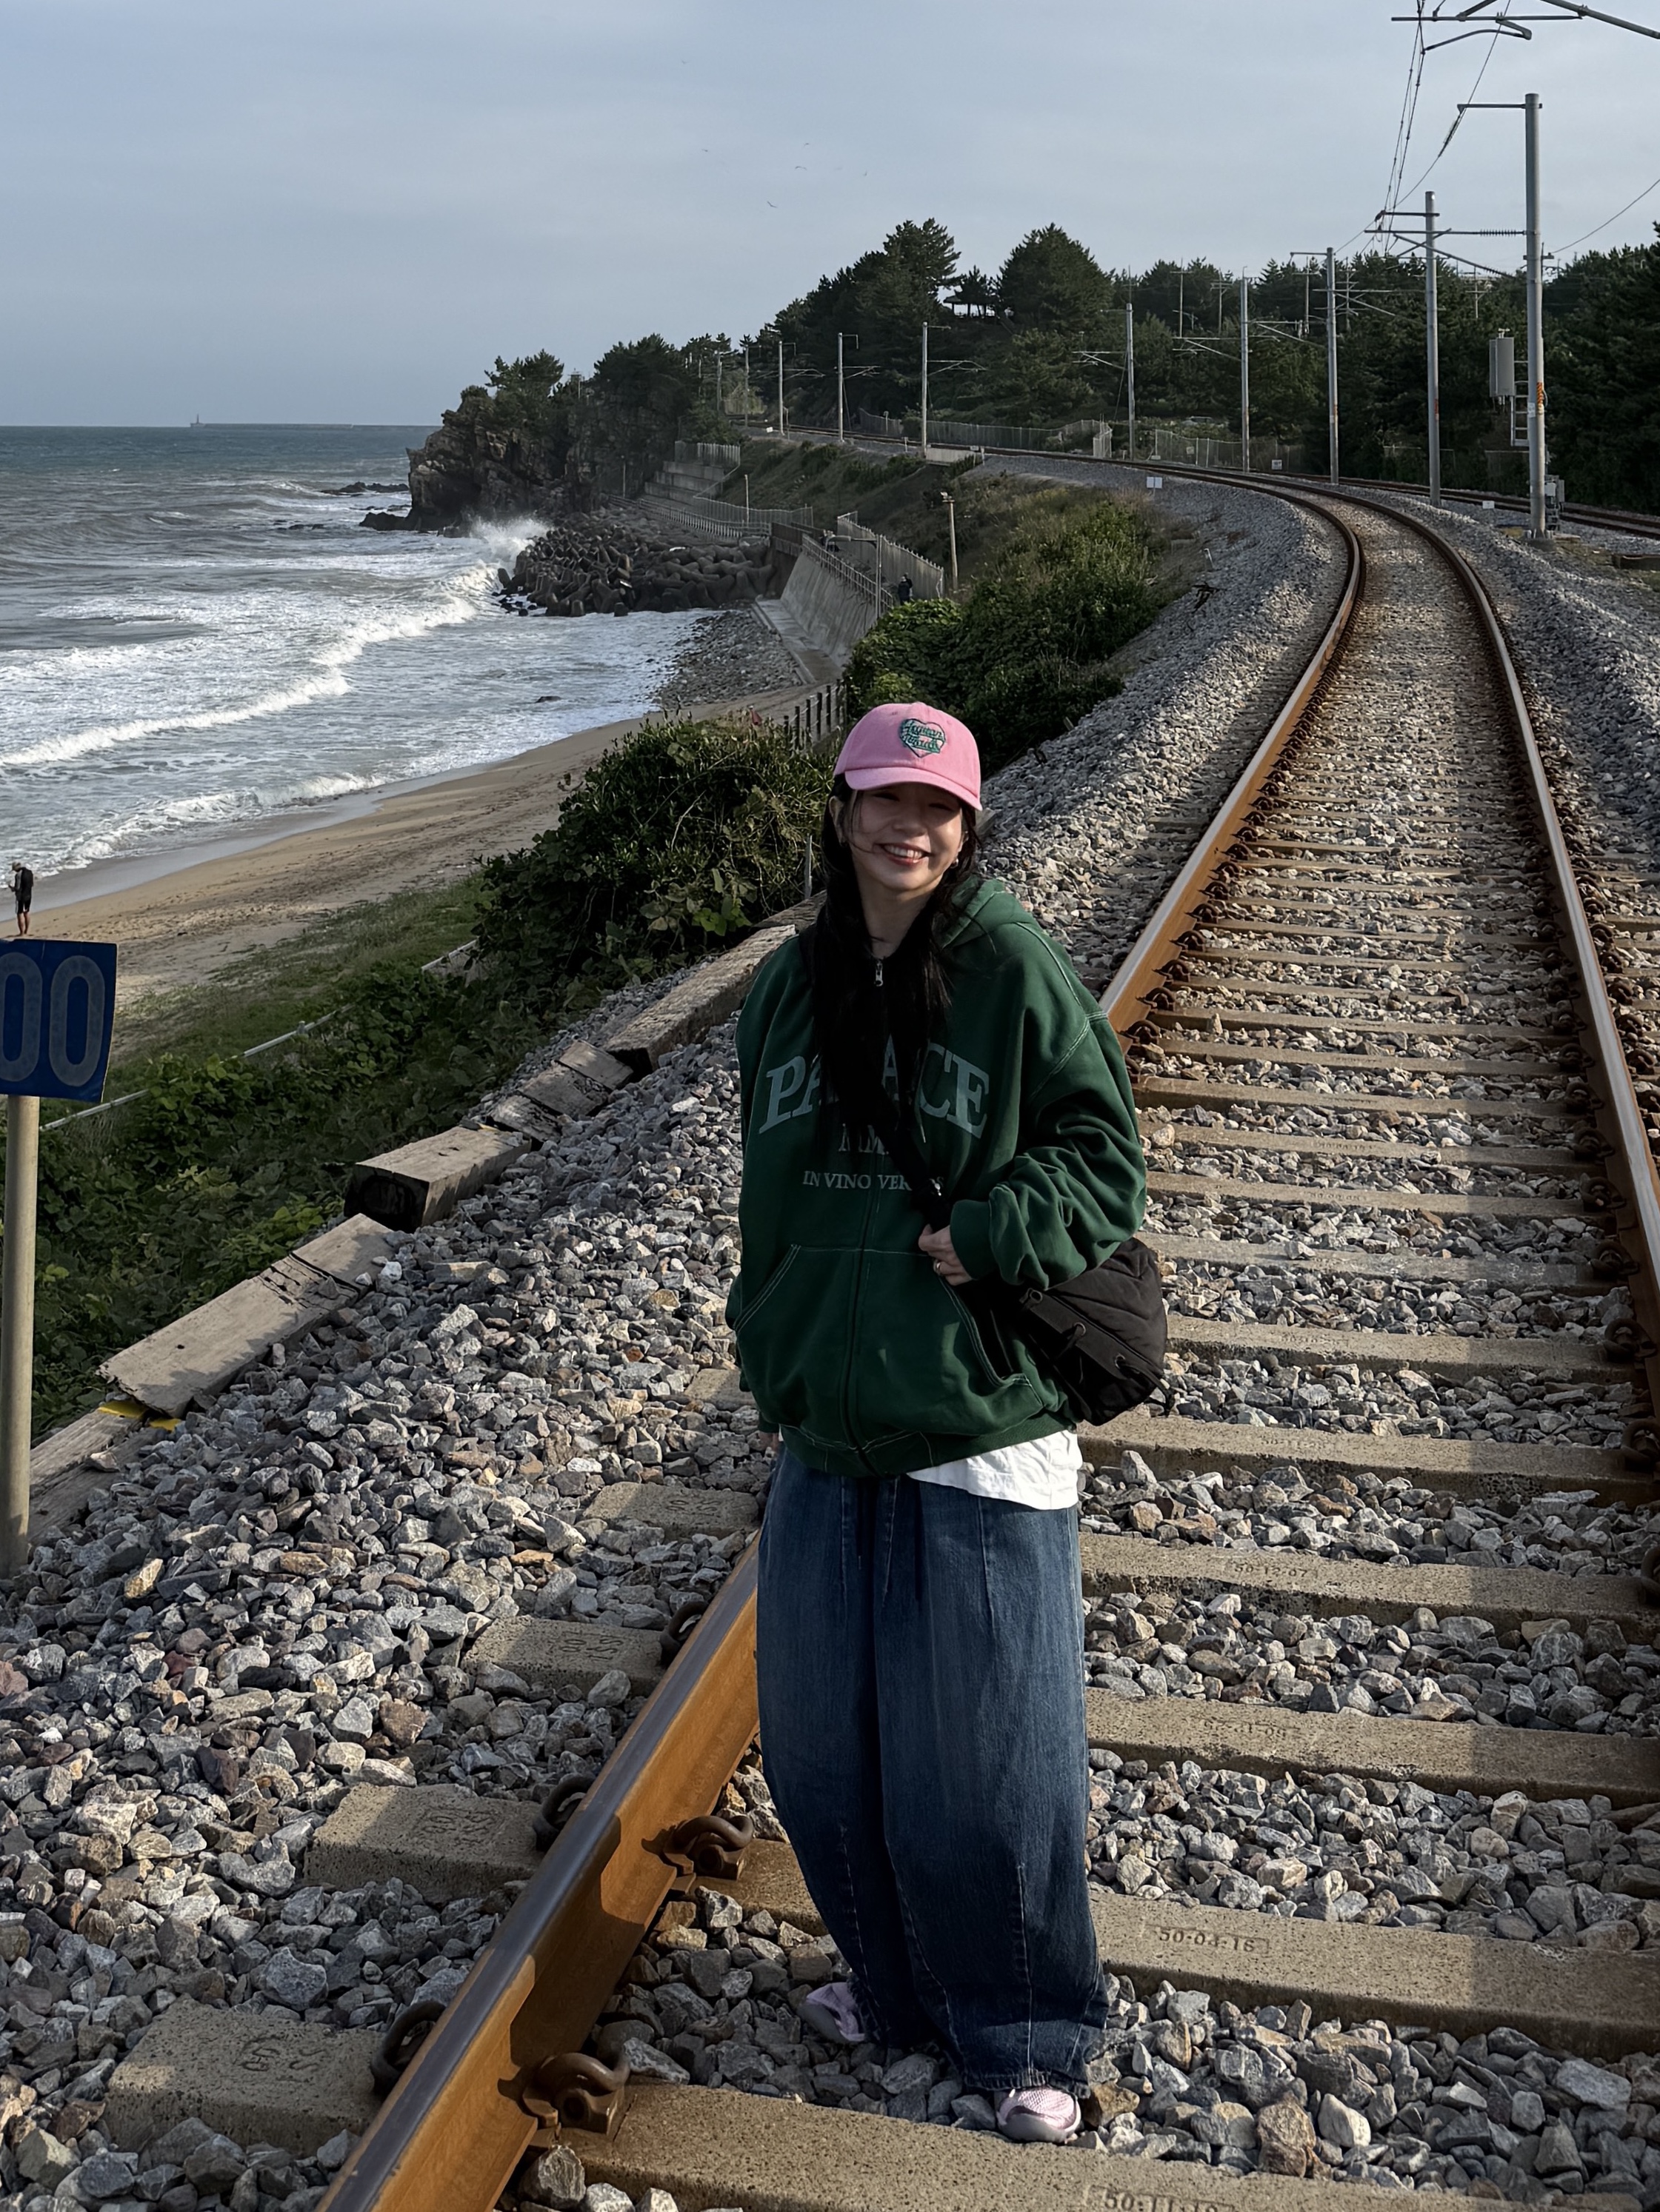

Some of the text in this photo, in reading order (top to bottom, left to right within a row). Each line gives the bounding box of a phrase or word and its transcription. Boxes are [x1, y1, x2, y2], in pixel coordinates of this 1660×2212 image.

[0, 952, 105, 1086] 00
[802, 1170, 821, 1188] IN
[823, 1172, 872, 1189] VINO
